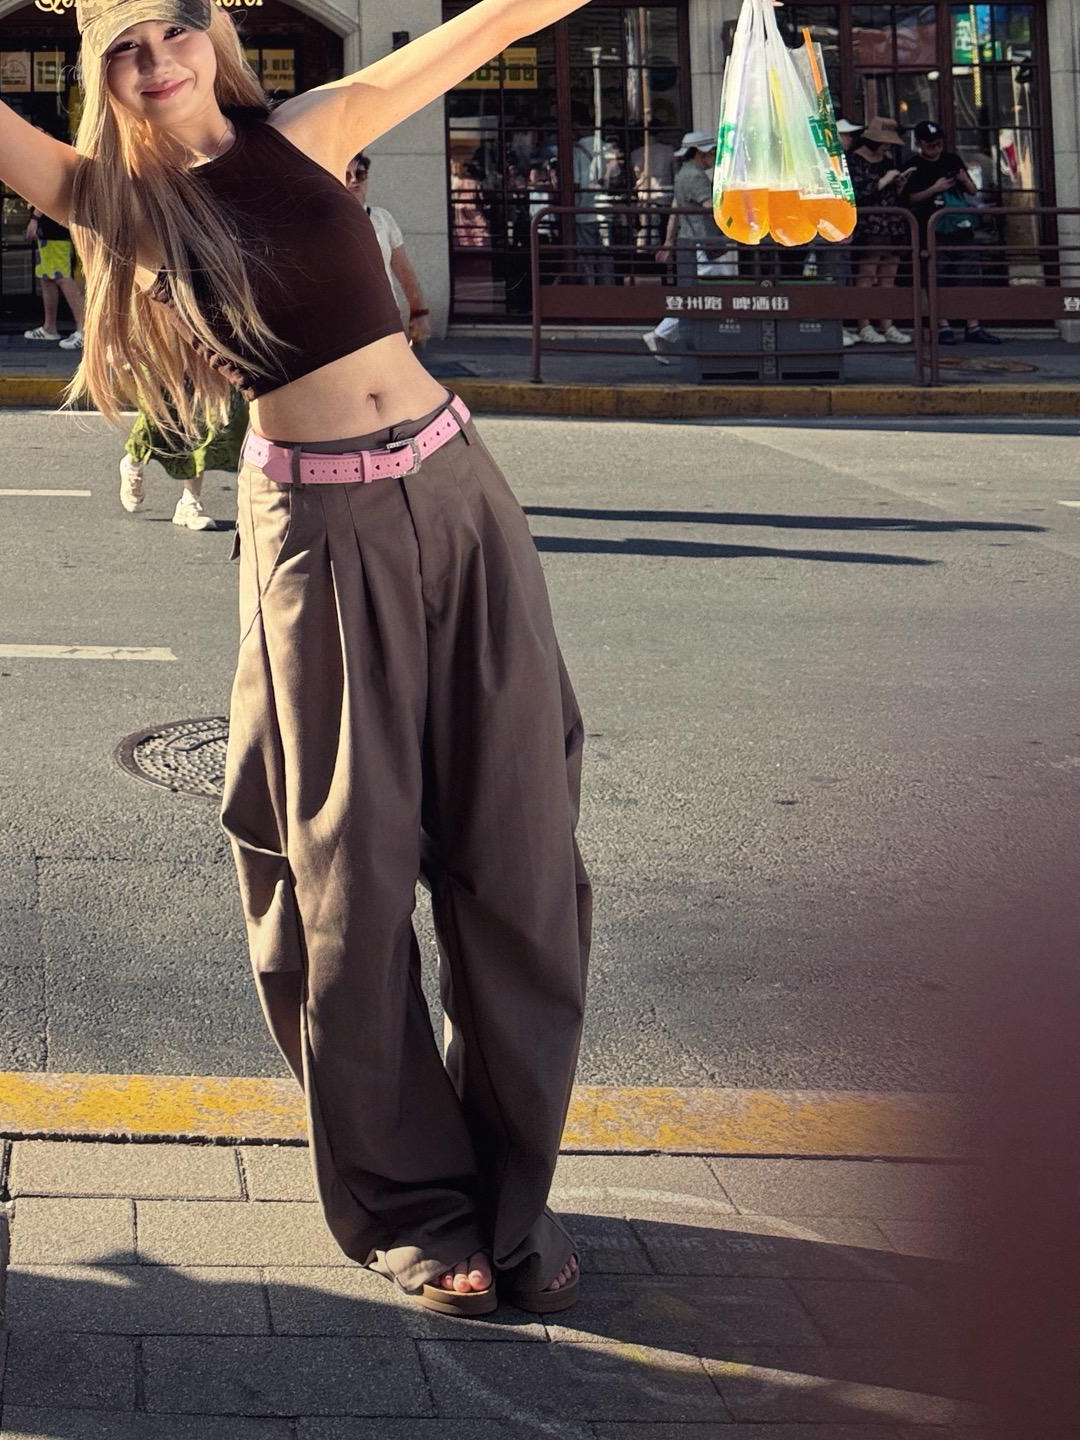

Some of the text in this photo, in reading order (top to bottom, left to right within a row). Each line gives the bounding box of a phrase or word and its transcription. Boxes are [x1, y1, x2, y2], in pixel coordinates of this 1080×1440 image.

[665, 296, 789, 310] 登州路 啤酒街
